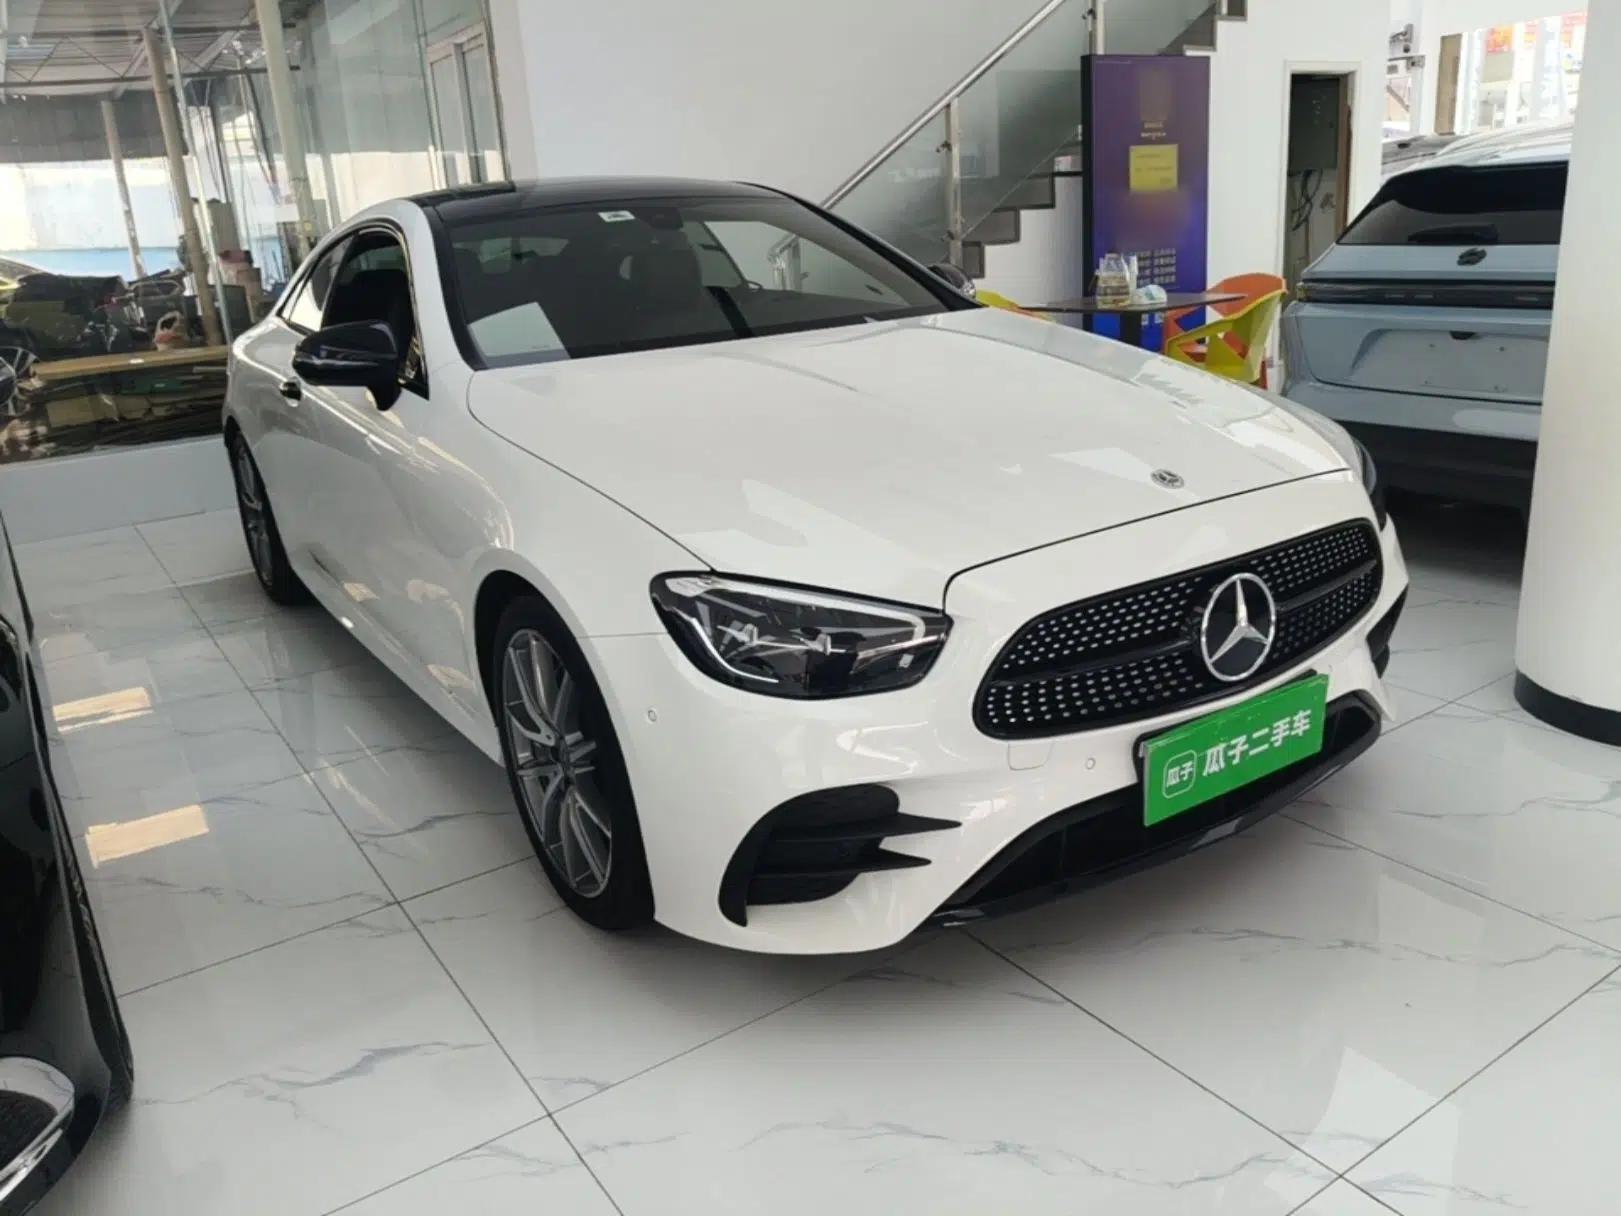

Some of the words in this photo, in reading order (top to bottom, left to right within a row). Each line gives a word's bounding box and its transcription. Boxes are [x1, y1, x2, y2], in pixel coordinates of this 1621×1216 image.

[1202, 709, 1311, 776] 瓜子二手车
[1166, 761, 1193, 787] 瓜子
